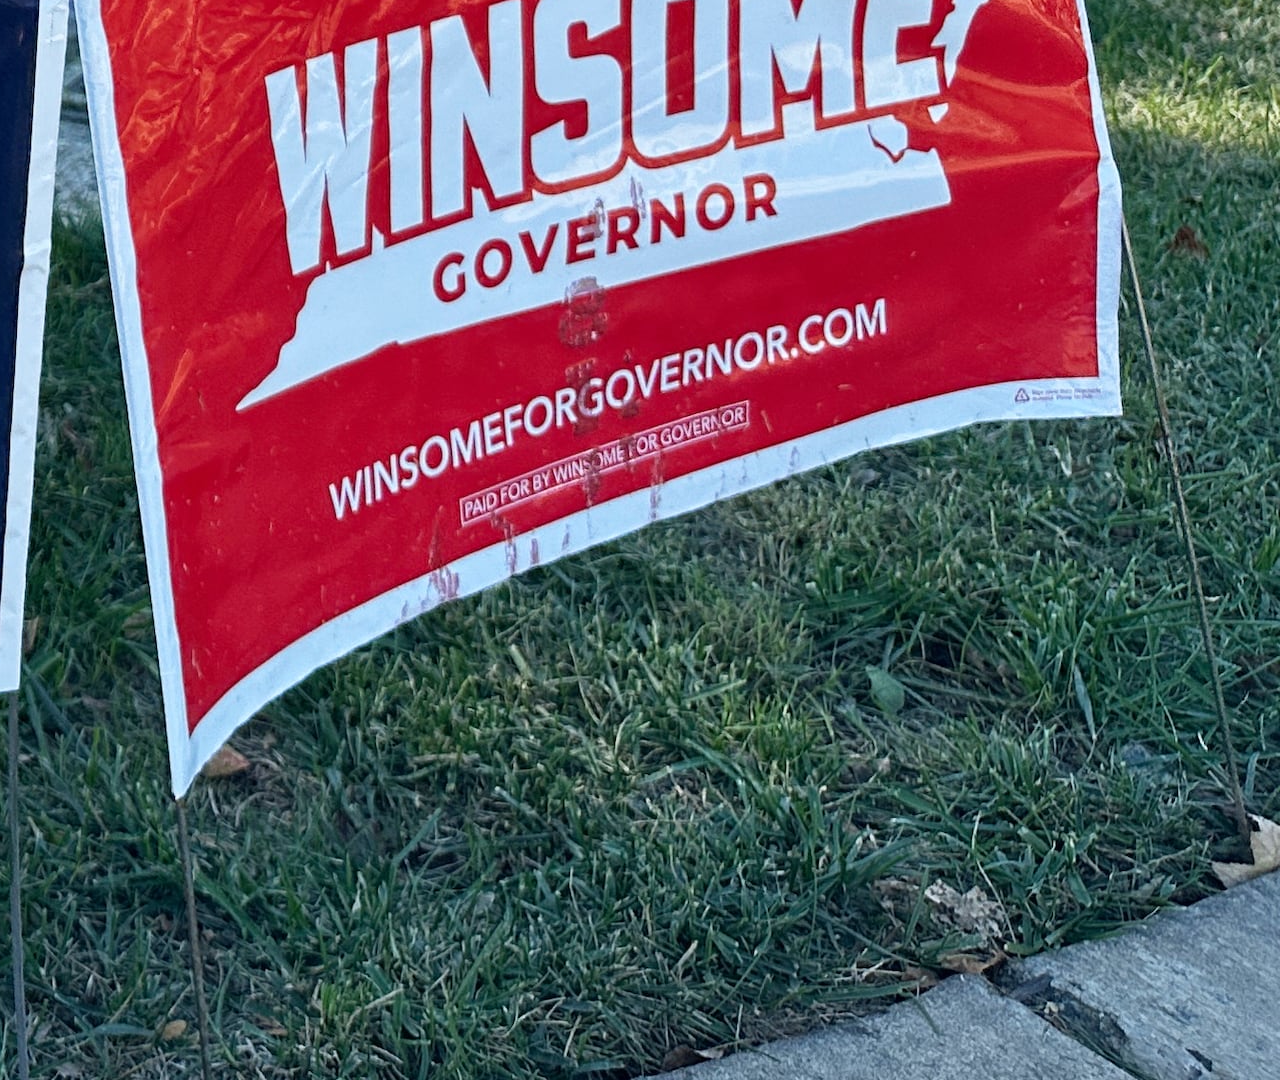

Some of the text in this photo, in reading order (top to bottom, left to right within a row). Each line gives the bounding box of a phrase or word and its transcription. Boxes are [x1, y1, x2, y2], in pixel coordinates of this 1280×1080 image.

[433, 172, 779, 303] GOVERNOR
[328, 298, 888, 519] WINSOMEFORGOVERNOR.COM
[464, 491, 498, 519] PAID
[500, 478, 530, 505] FOR
[532, 471, 551, 492] BY
[660, 406, 745, 446] GOVERNOR
